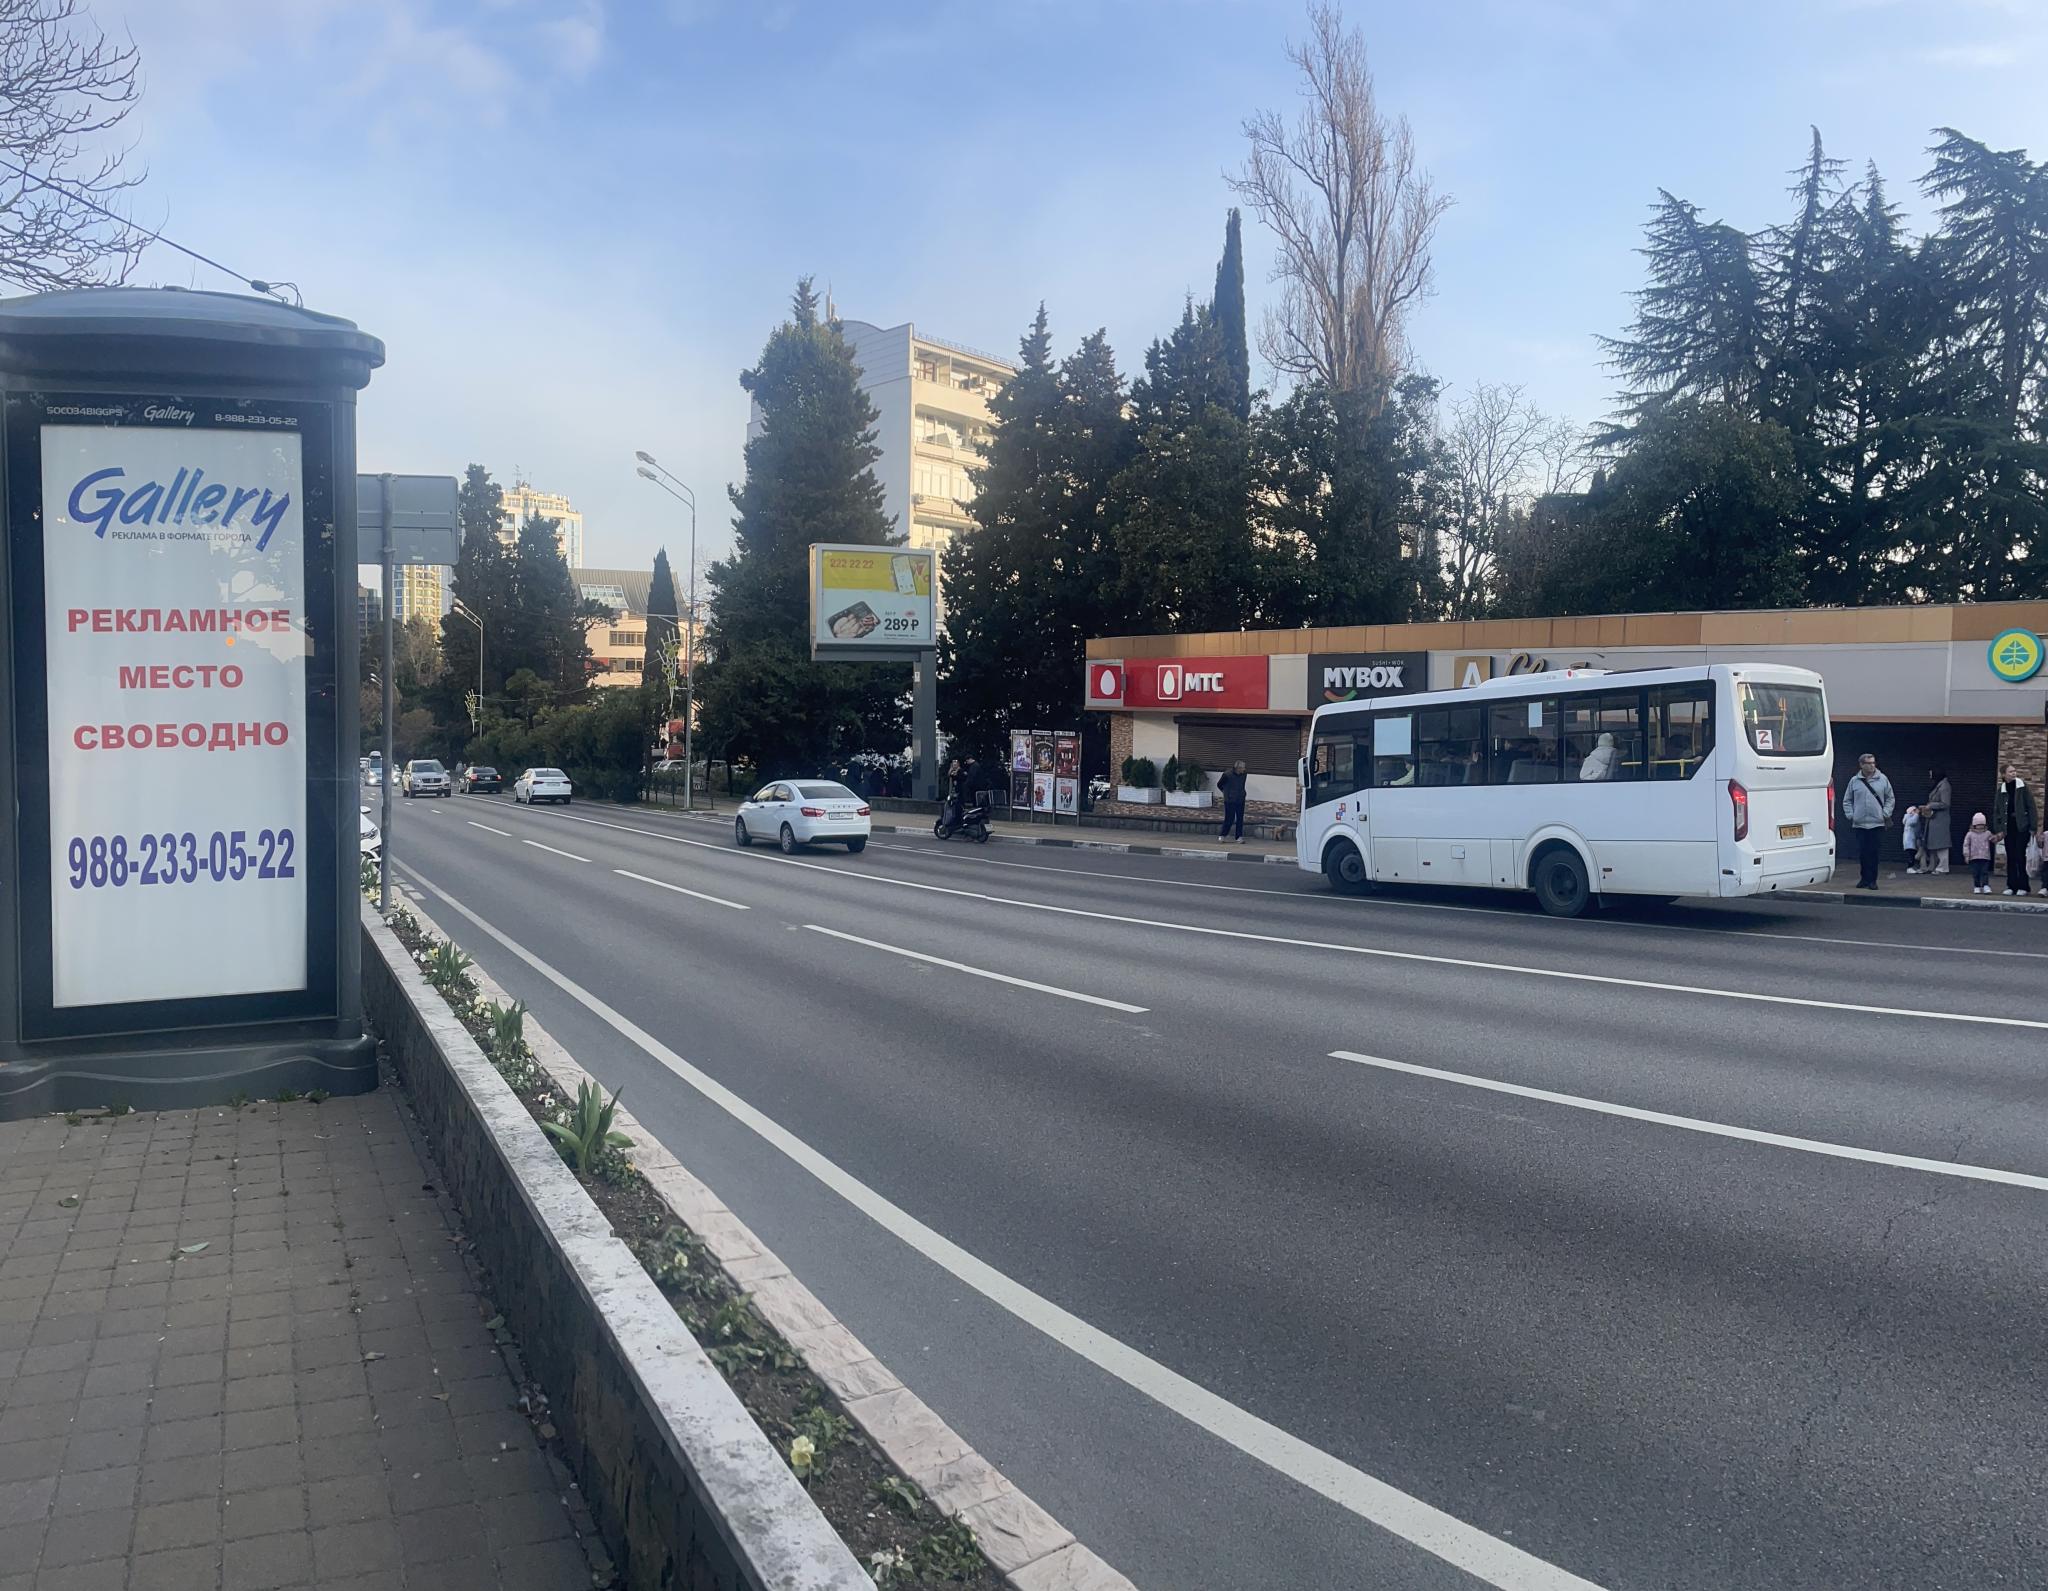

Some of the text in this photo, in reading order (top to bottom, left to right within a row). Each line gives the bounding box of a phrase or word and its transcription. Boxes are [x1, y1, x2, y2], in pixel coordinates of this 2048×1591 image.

[143, 405, 196, 426] Gallery
[215, 413, 298, 426] 8-988-233-05-22
[67, 467, 291, 553] Gallery
[111, 531, 252, 543] РЕКЛАМА В ФОРМАТЕ ГОРОДА
[68, 609, 291, 632] РЕКЛАМНОЕ
[884, 618, 909, 631] 289
[119, 665, 244, 689] МЕСТО
[1185, 672, 1224, 692] МТС
[1323, 666, 1404, 689] MYBOX
[73, 722, 289, 751] СВОБОДНО
[68, 828, 295, 889] 988-233-05-22
